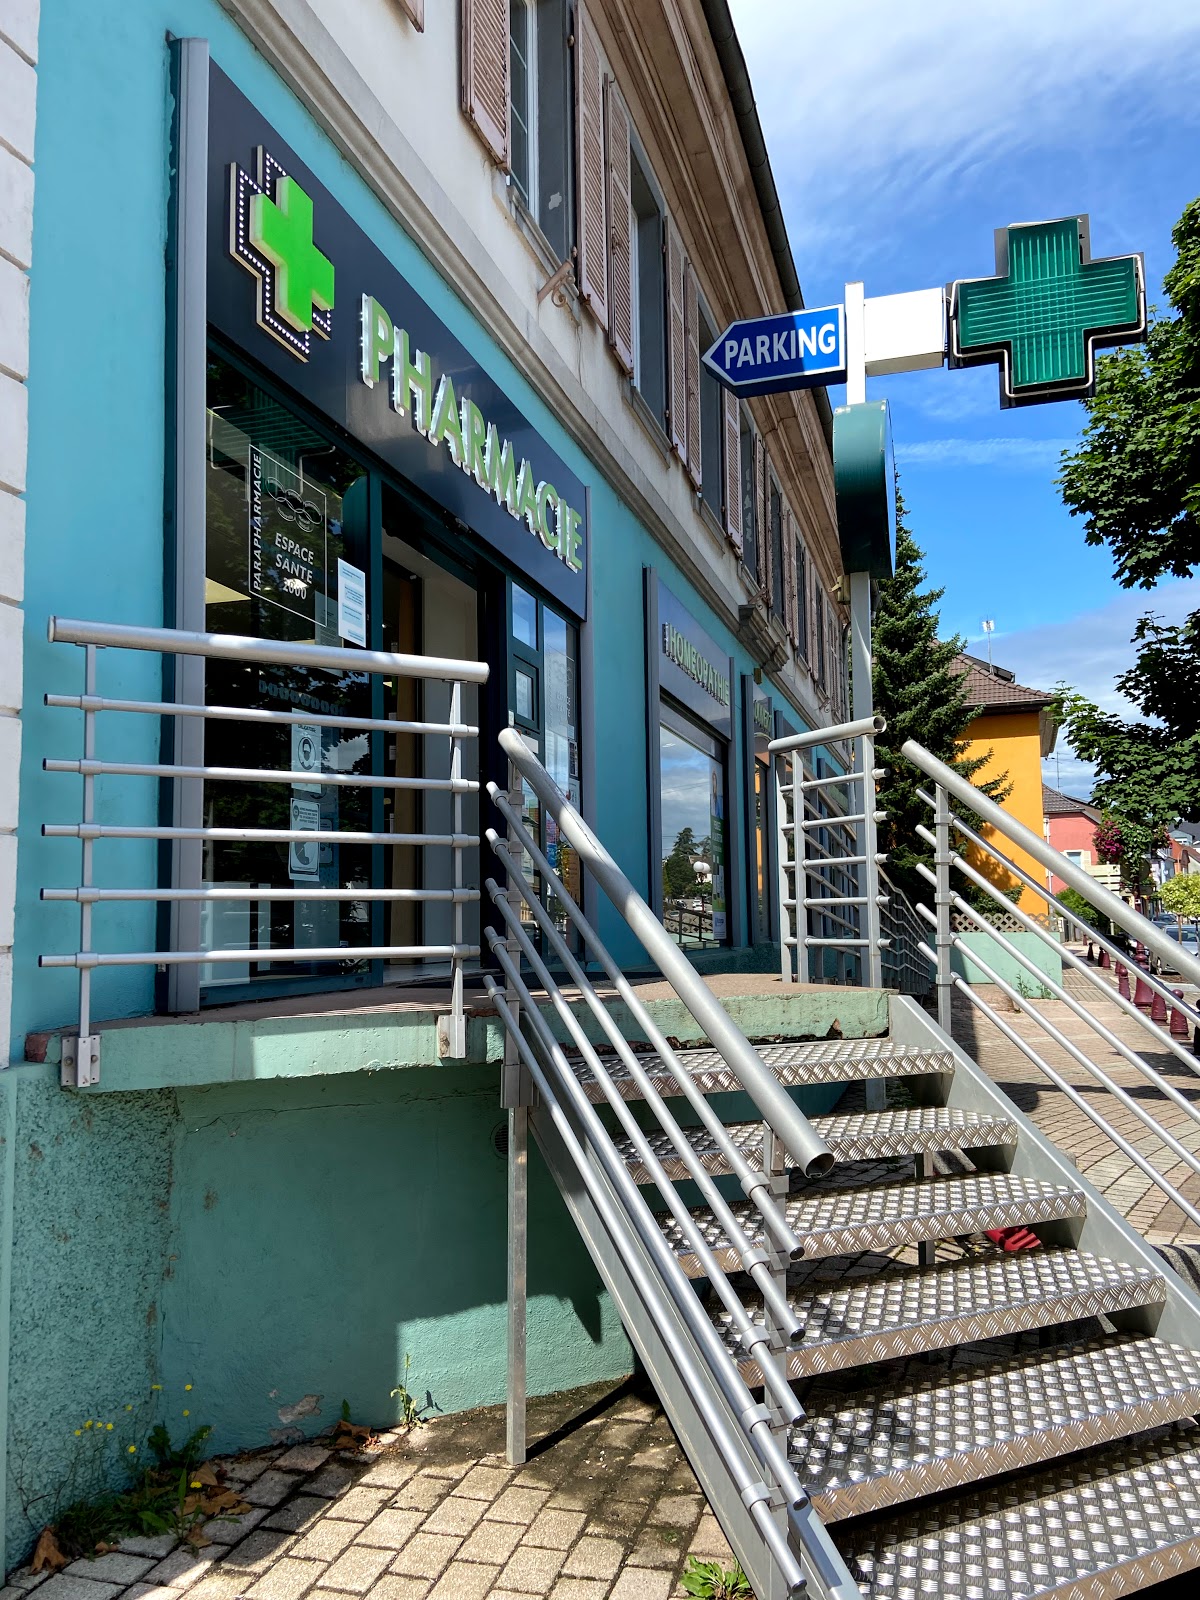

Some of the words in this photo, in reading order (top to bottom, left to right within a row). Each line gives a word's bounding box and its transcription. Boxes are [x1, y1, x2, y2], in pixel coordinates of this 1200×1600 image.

[724, 323, 836, 370] PARKING
[361, 293, 582, 574] PHARMACIE
[253, 453, 262, 591] PARAPHARMACIE
[275, 532, 315, 565] ESPACE
[275, 553, 313, 584] SANTE
[282, 577, 307, 600] 2000
[665, 622, 730, 708] HOMEOPATHIE
